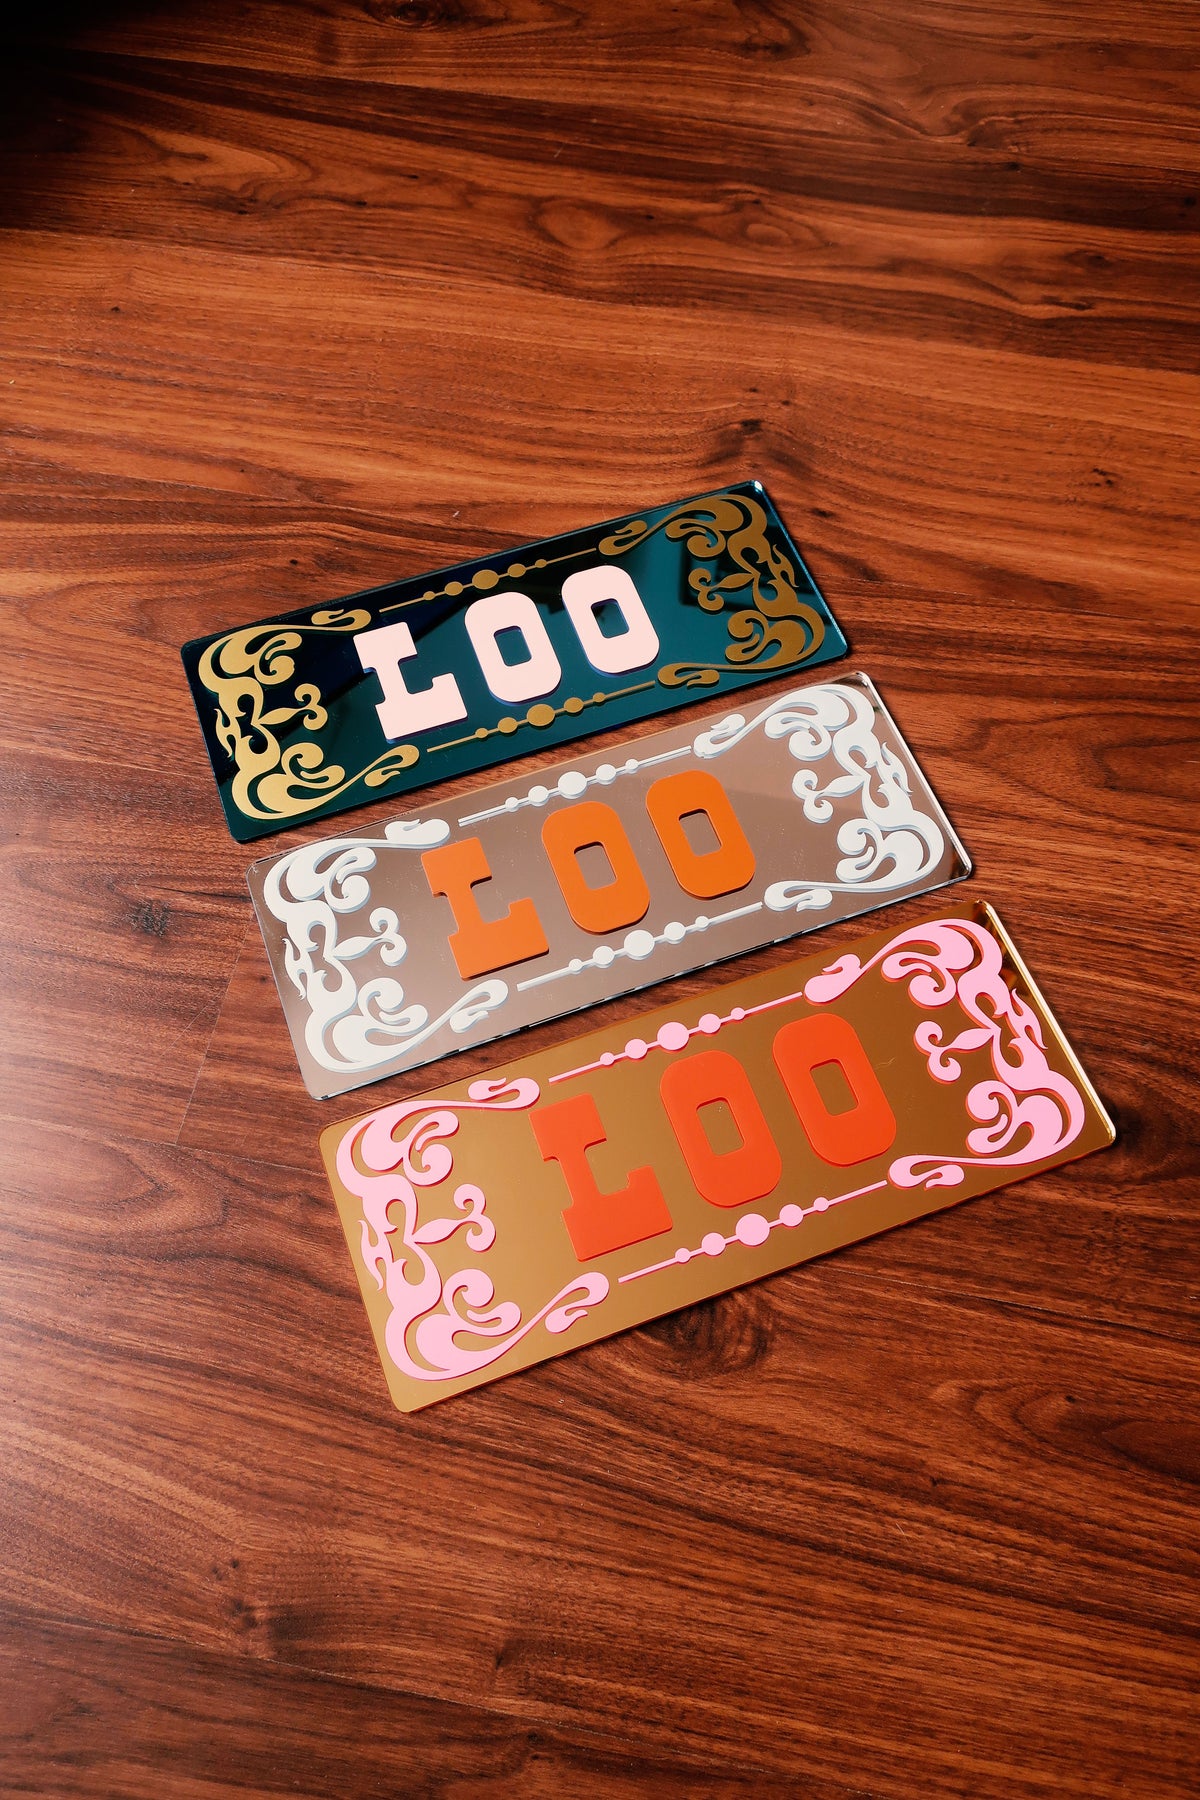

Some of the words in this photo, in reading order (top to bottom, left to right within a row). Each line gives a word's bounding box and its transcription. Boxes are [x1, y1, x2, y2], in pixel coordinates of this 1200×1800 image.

[353, 565, 660, 743] LOO
[420, 769, 757, 979] LOO
[530, 1013, 897, 1261] LOO
